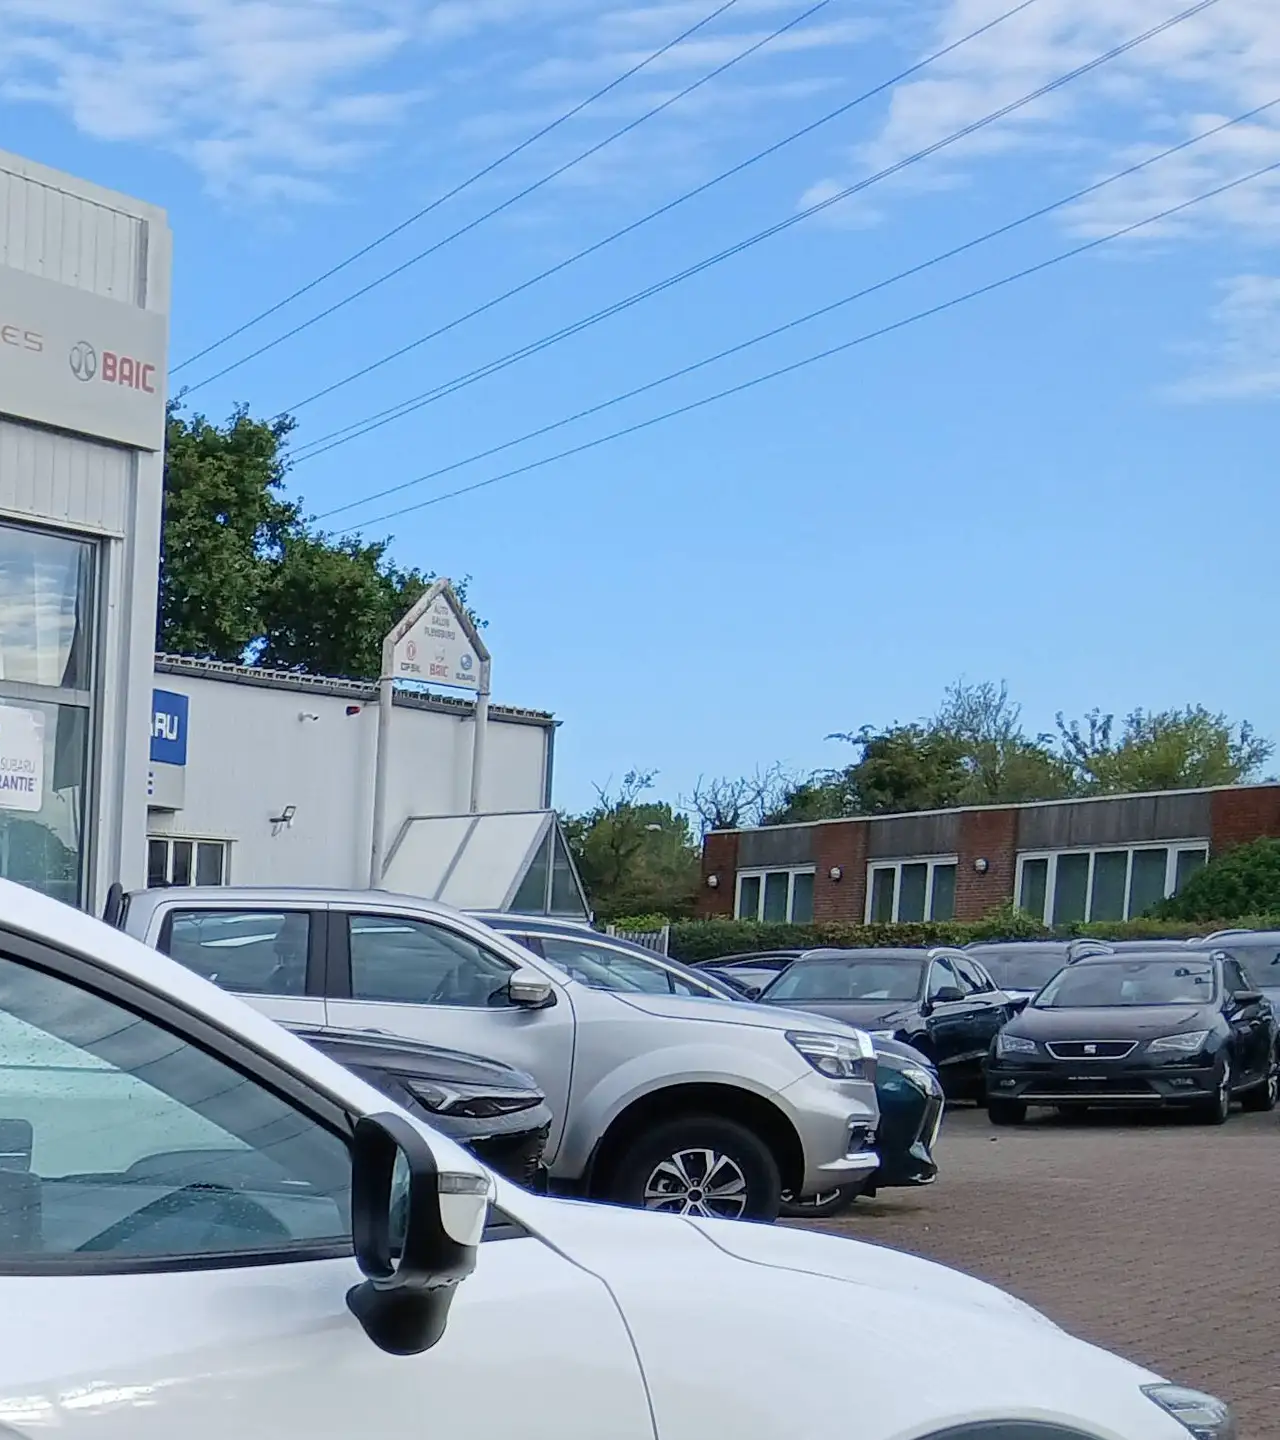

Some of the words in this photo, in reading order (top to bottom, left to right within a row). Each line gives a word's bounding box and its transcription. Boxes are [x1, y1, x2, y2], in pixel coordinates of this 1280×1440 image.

[101, 351, 155, 393] BAIC
[150, 712, 179, 740] RU
[0, 757, 36, 773] SUBARU
